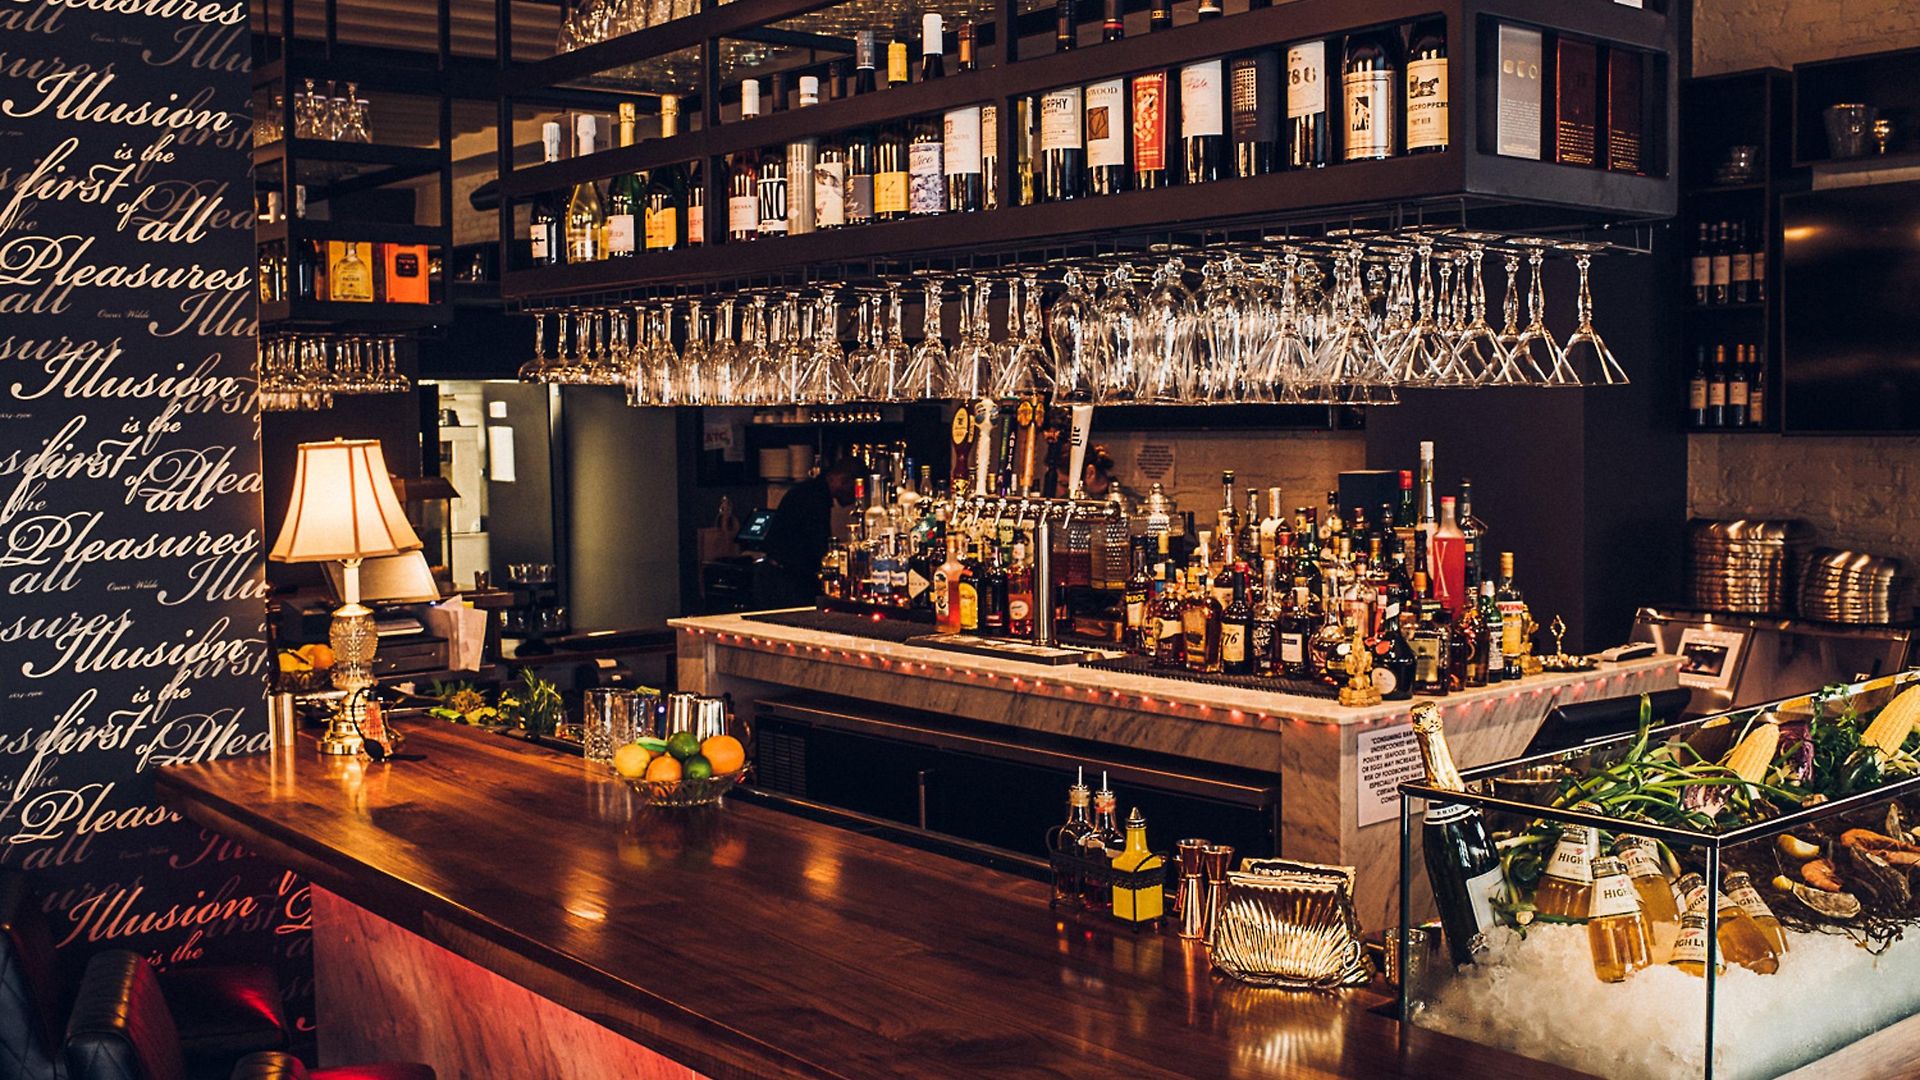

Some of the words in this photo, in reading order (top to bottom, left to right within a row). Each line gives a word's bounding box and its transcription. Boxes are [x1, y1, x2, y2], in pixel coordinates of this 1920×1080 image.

[2, 71, 233, 132] Illusion
[114, 143, 132, 160] is
[140, 134, 175, 163] the
[0, 137, 136, 240] first
[116, 186, 155, 232] of
[137, 196, 224, 244] all
[0, 235, 252, 291] Pleasures
[11, 347, 238, 400] Illusion
[121, 416, 140, 434] is
[147, 403, 182, 433] the
[0, 415, 143, 523] first
[0, 511, 259, 567] Pleasures
[22, 626, 247, 679] Illusion
[132, 685, 149, 703] is
[13, 688, 154, 803] first
[10, 782, 182, 844] Pleas
[56, 886, 259, 949] Illusion
[170, 929, 205, 963] the
